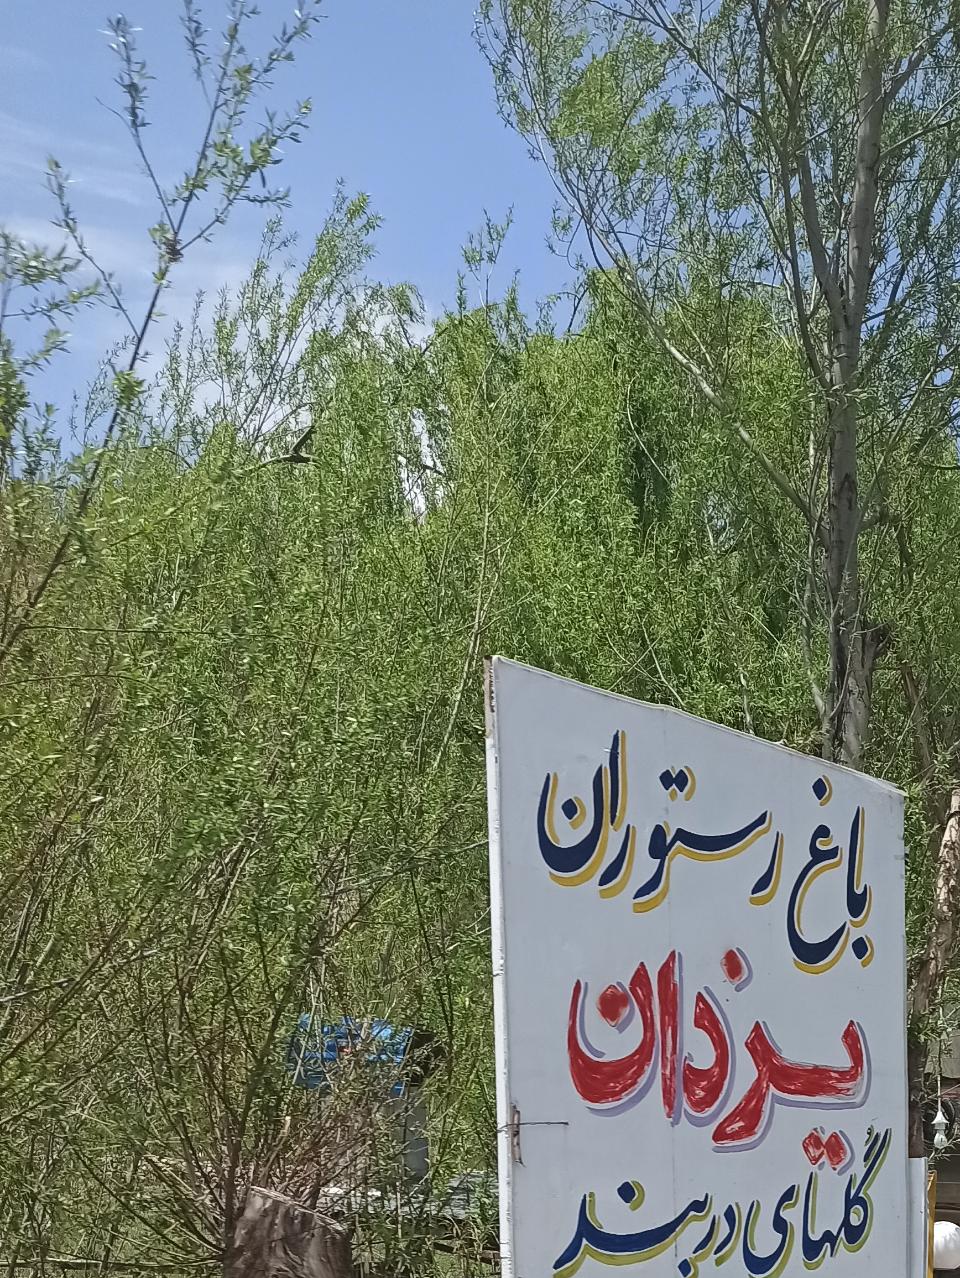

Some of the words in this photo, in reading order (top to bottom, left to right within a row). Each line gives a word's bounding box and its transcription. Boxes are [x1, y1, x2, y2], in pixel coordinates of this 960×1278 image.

[537, 729, 783, 914] رستوران
[786, 774, 874, 974] باغ
[567, 946, 873, 1174] یزدان
